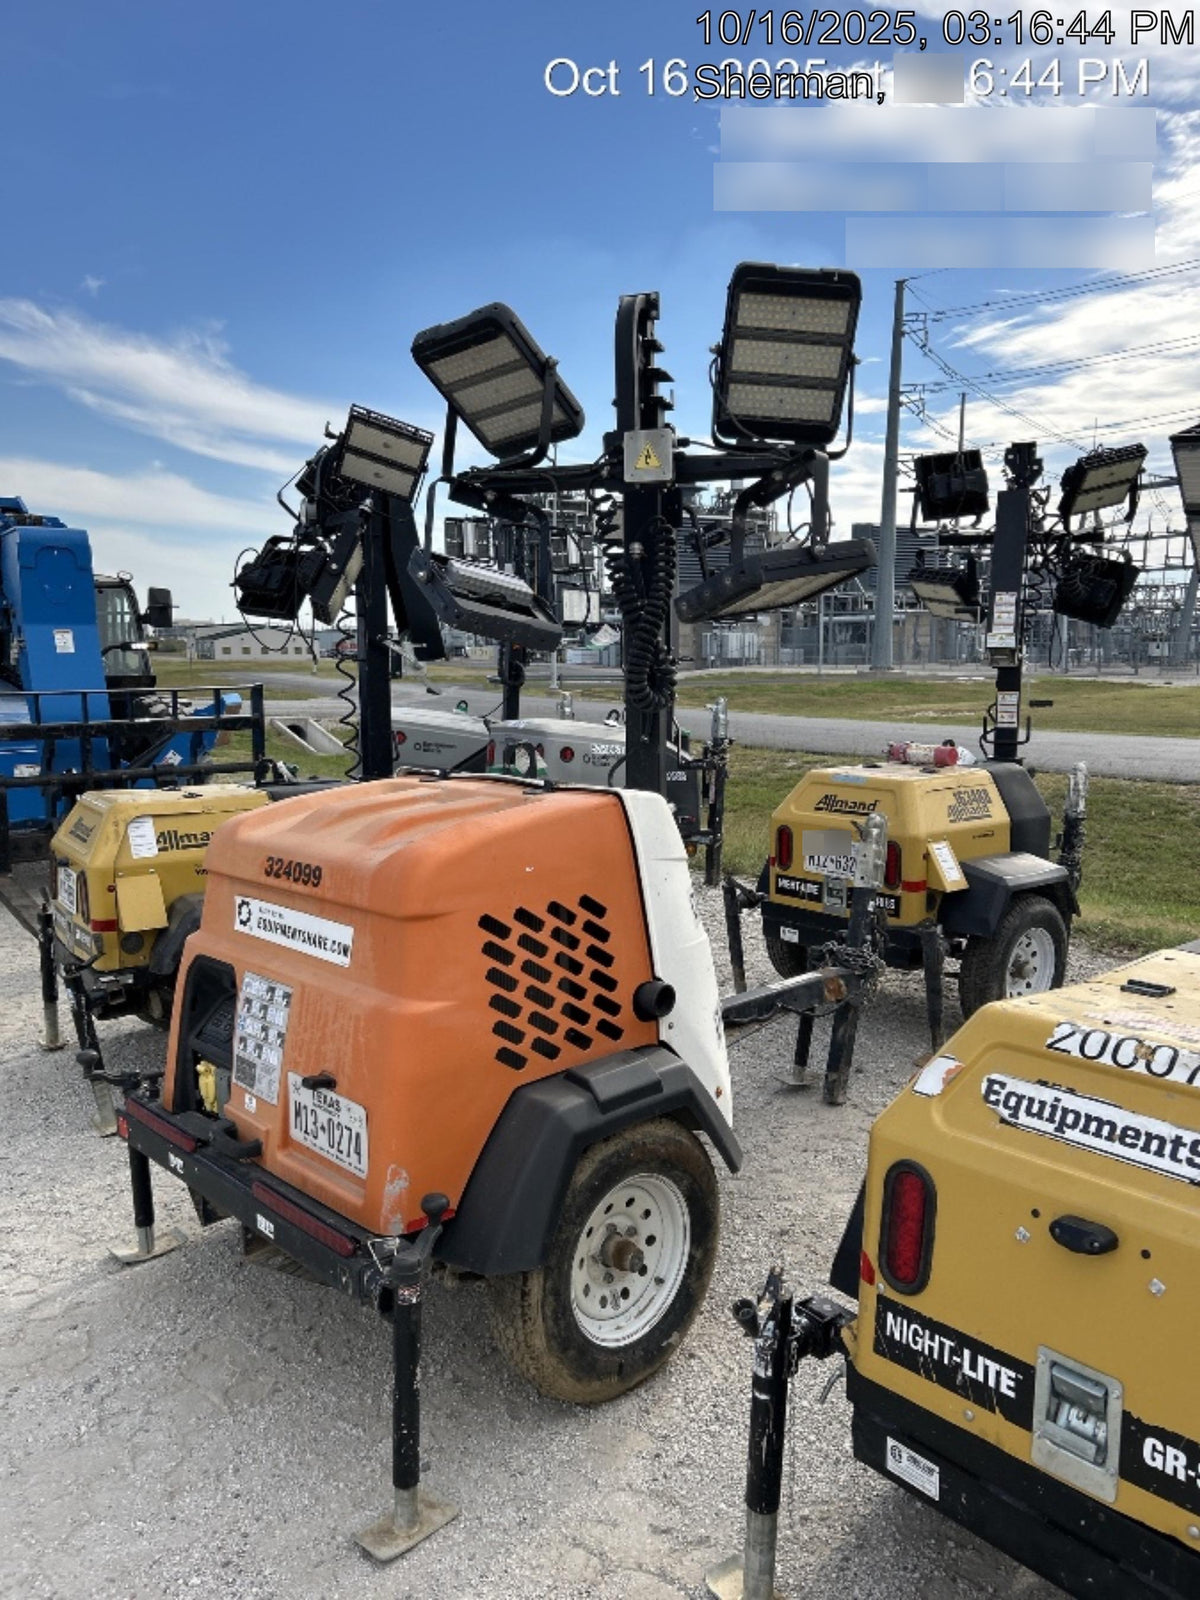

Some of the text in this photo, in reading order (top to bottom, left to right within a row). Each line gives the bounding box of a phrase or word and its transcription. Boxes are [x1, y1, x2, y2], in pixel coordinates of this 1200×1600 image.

[815, 794, 880, 816] Allmand
[156, 830, 214, 852] Allma
[264, 856, 322, 887] 324099
[886, 1311, 1016, 1399] NIGHT-LITE
